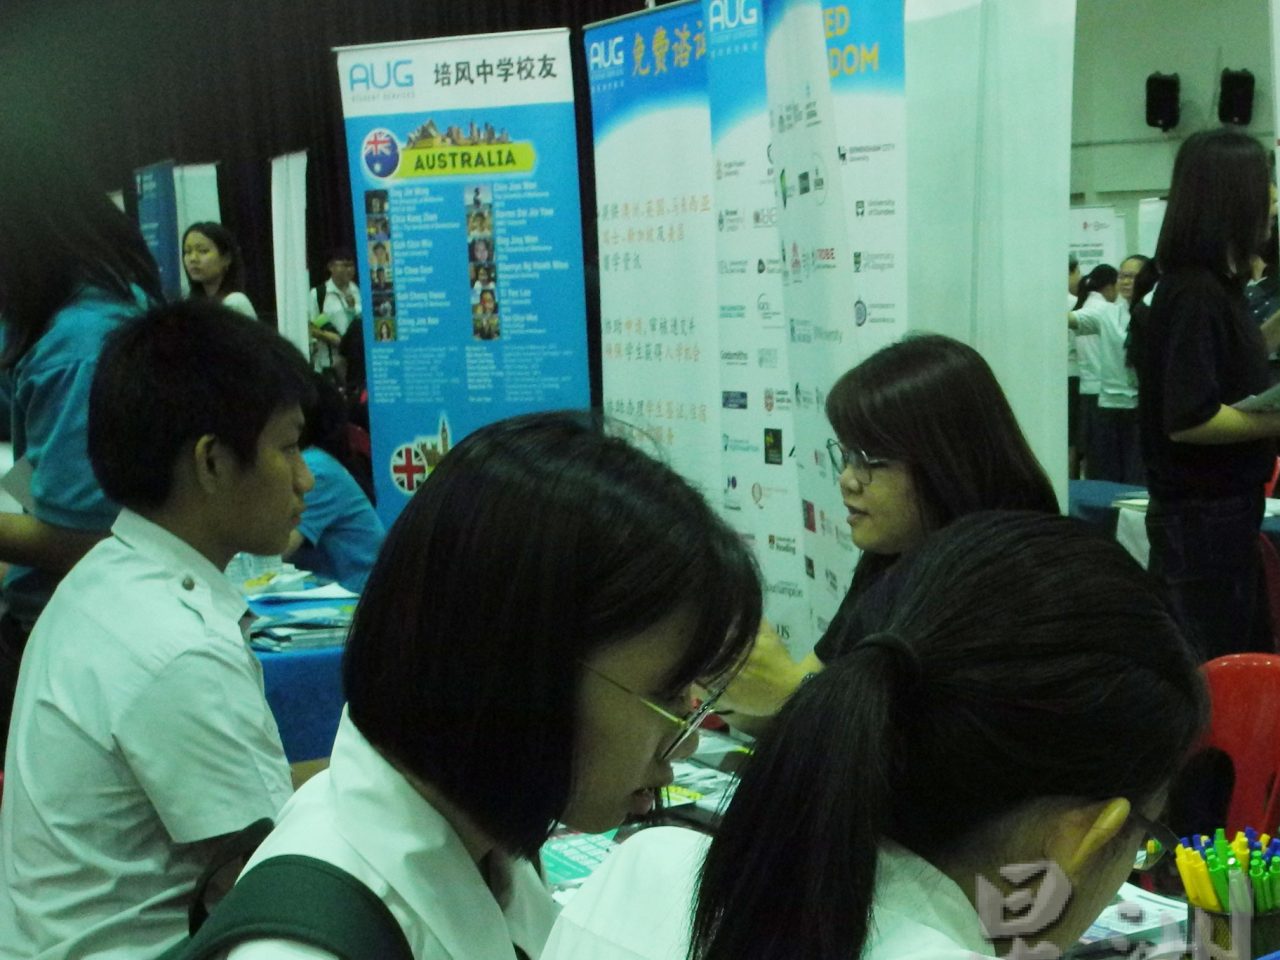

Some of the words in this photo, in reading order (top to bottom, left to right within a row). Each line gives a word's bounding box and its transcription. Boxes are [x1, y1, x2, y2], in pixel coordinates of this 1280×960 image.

[709, 0, 758, 32] AUG
[590, 35, 624, 71] AUG
[349, 59, 414, 92] AUG
[433, 54, 558, 88] 培风中学校友
[414, 149, 516, 171] AUSTRALIA
